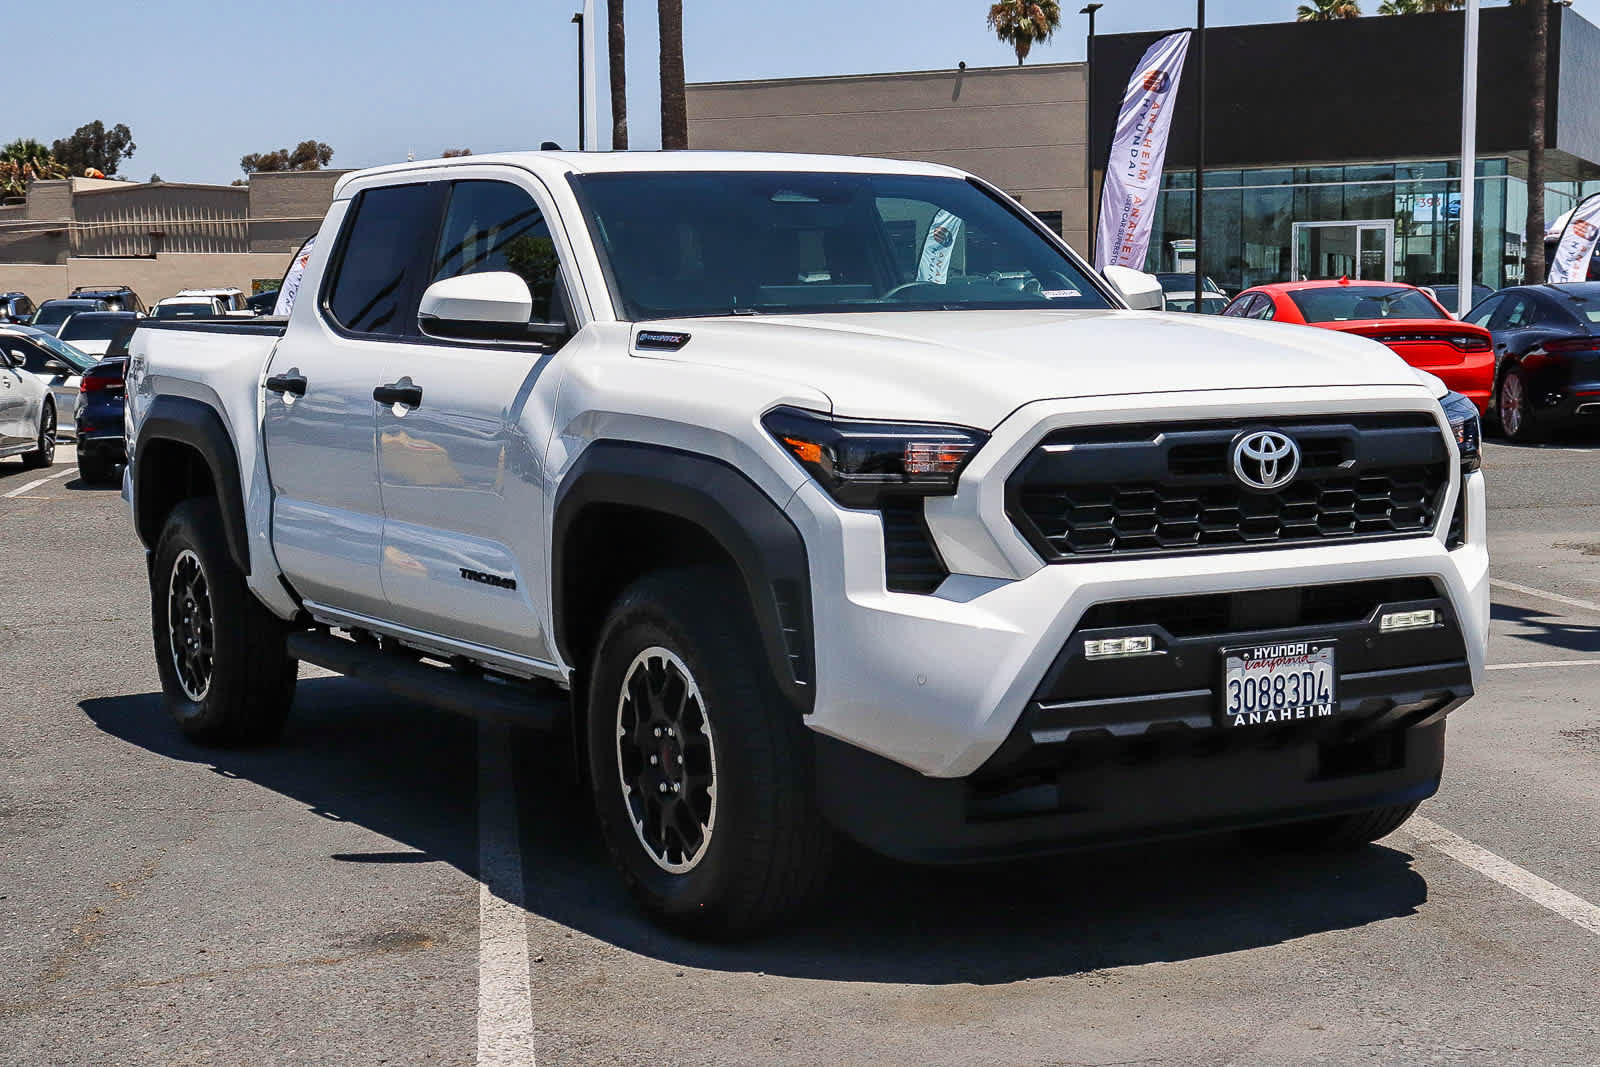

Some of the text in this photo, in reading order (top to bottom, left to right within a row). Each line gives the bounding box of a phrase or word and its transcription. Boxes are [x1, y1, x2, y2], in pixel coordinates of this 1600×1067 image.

[1128, 98, 1151, 177] HYUNDAI
[1138, 101, 1160, 180] ANAHEIM
[1244, 653, 1317, 673] California
[1254, 643, 1308, 660] HYUNDAI
[1228, 669, 1329, 714] 30883D4
[1233, 703, 1332, 726] ANAHEIM
